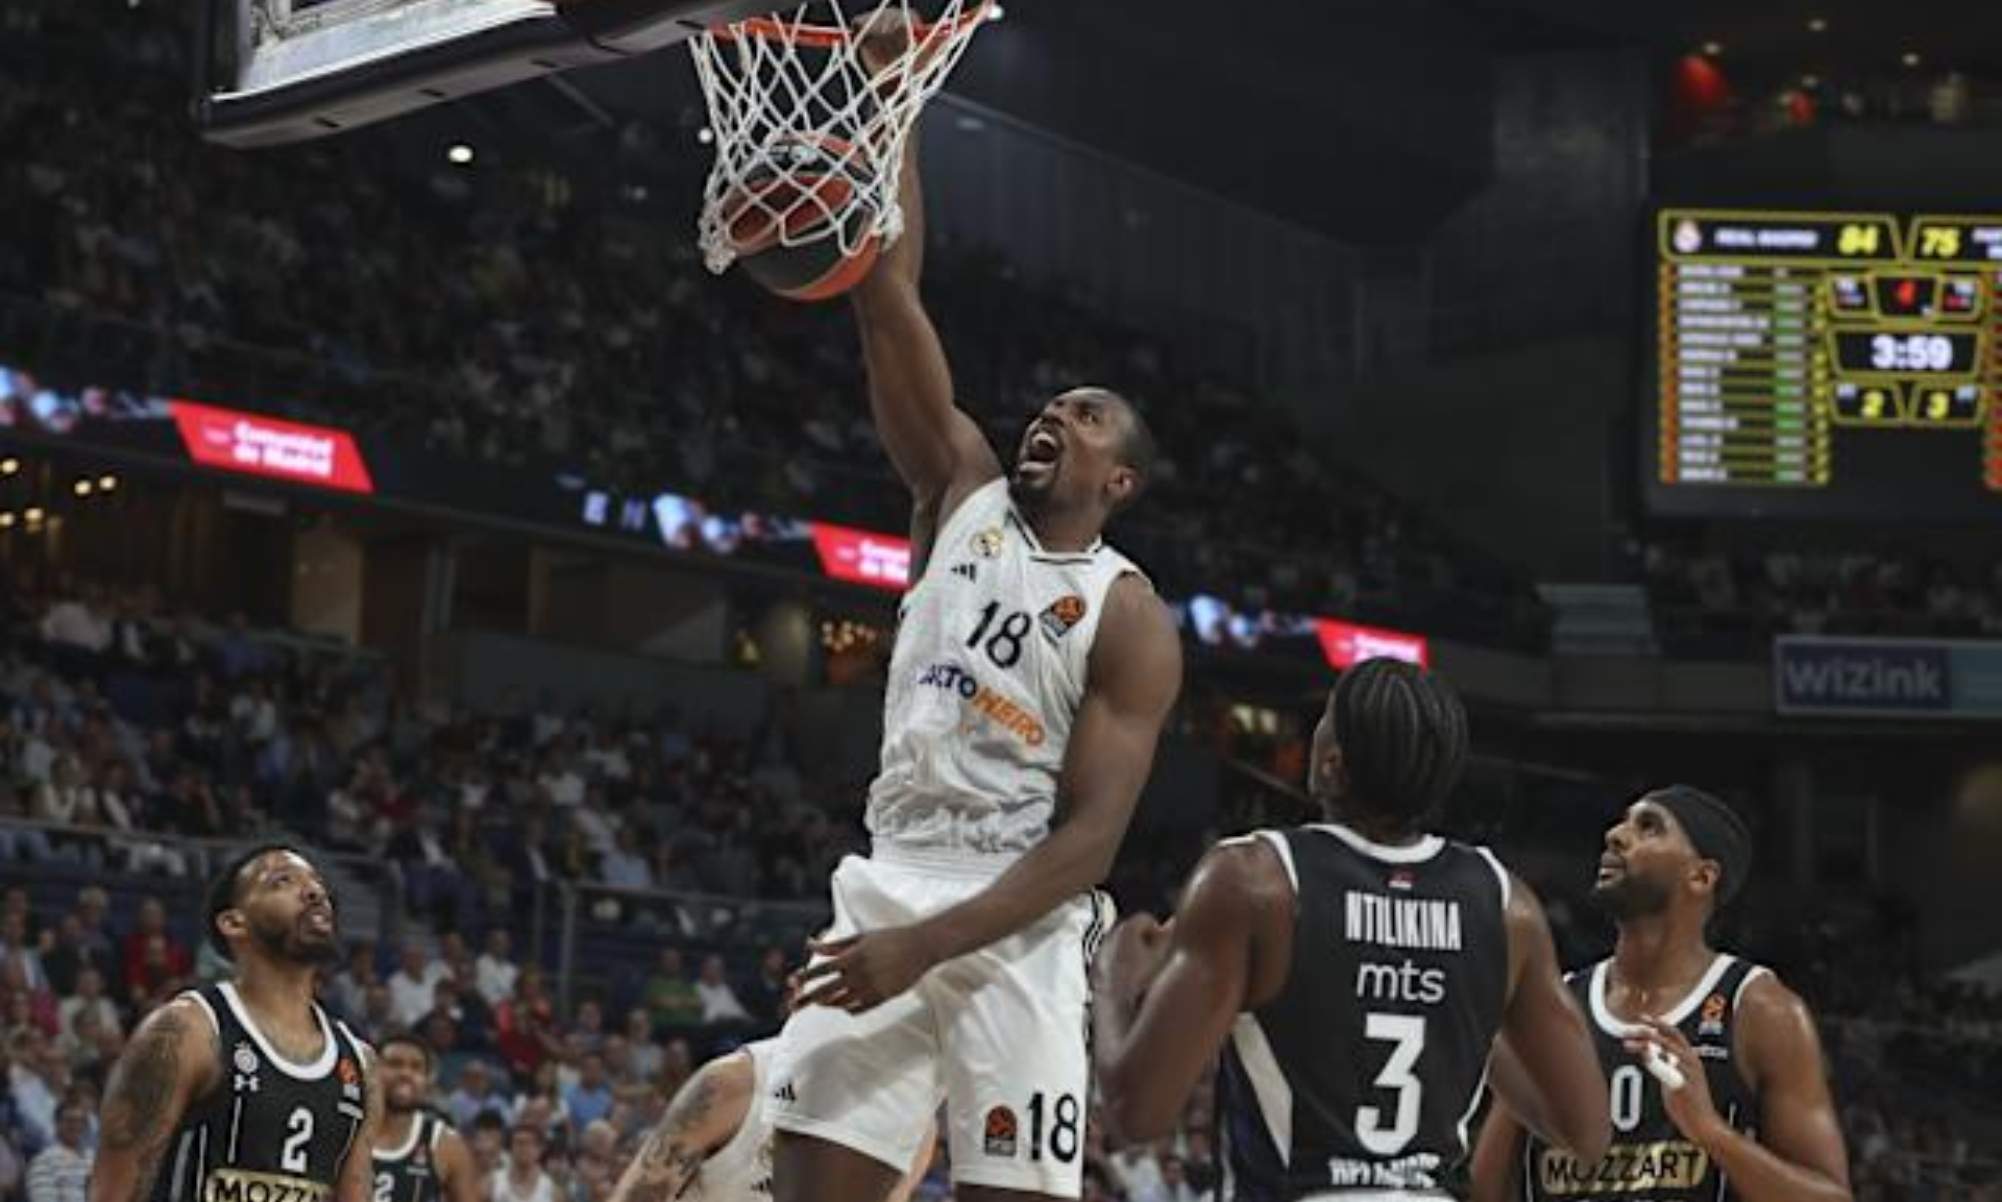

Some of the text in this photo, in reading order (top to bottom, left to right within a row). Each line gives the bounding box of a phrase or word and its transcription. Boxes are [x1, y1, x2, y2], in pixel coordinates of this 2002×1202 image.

[1839, 224, 1878, 255] 84
[1922, 227, 1959, 256] 75
[1871, 334, 1953, 370] 3:59
[1862, 391, 1884, 418] 2
[1928, 391, 1949, 419] 3
[966, 599, 1032, 669] 18
[1345, 890, 1462, 951] NTILIKINA
[1356, 959, 1446, 1003] mts
[1354, 1012, 1426, 1156] 3
[1610, 1064, 1643, 1132] 0
[281, 1107, 315, 1174] 2
[1028, 1092, 1079, 1163] 18
[214, 1176, 320, 1202] MOZZ
